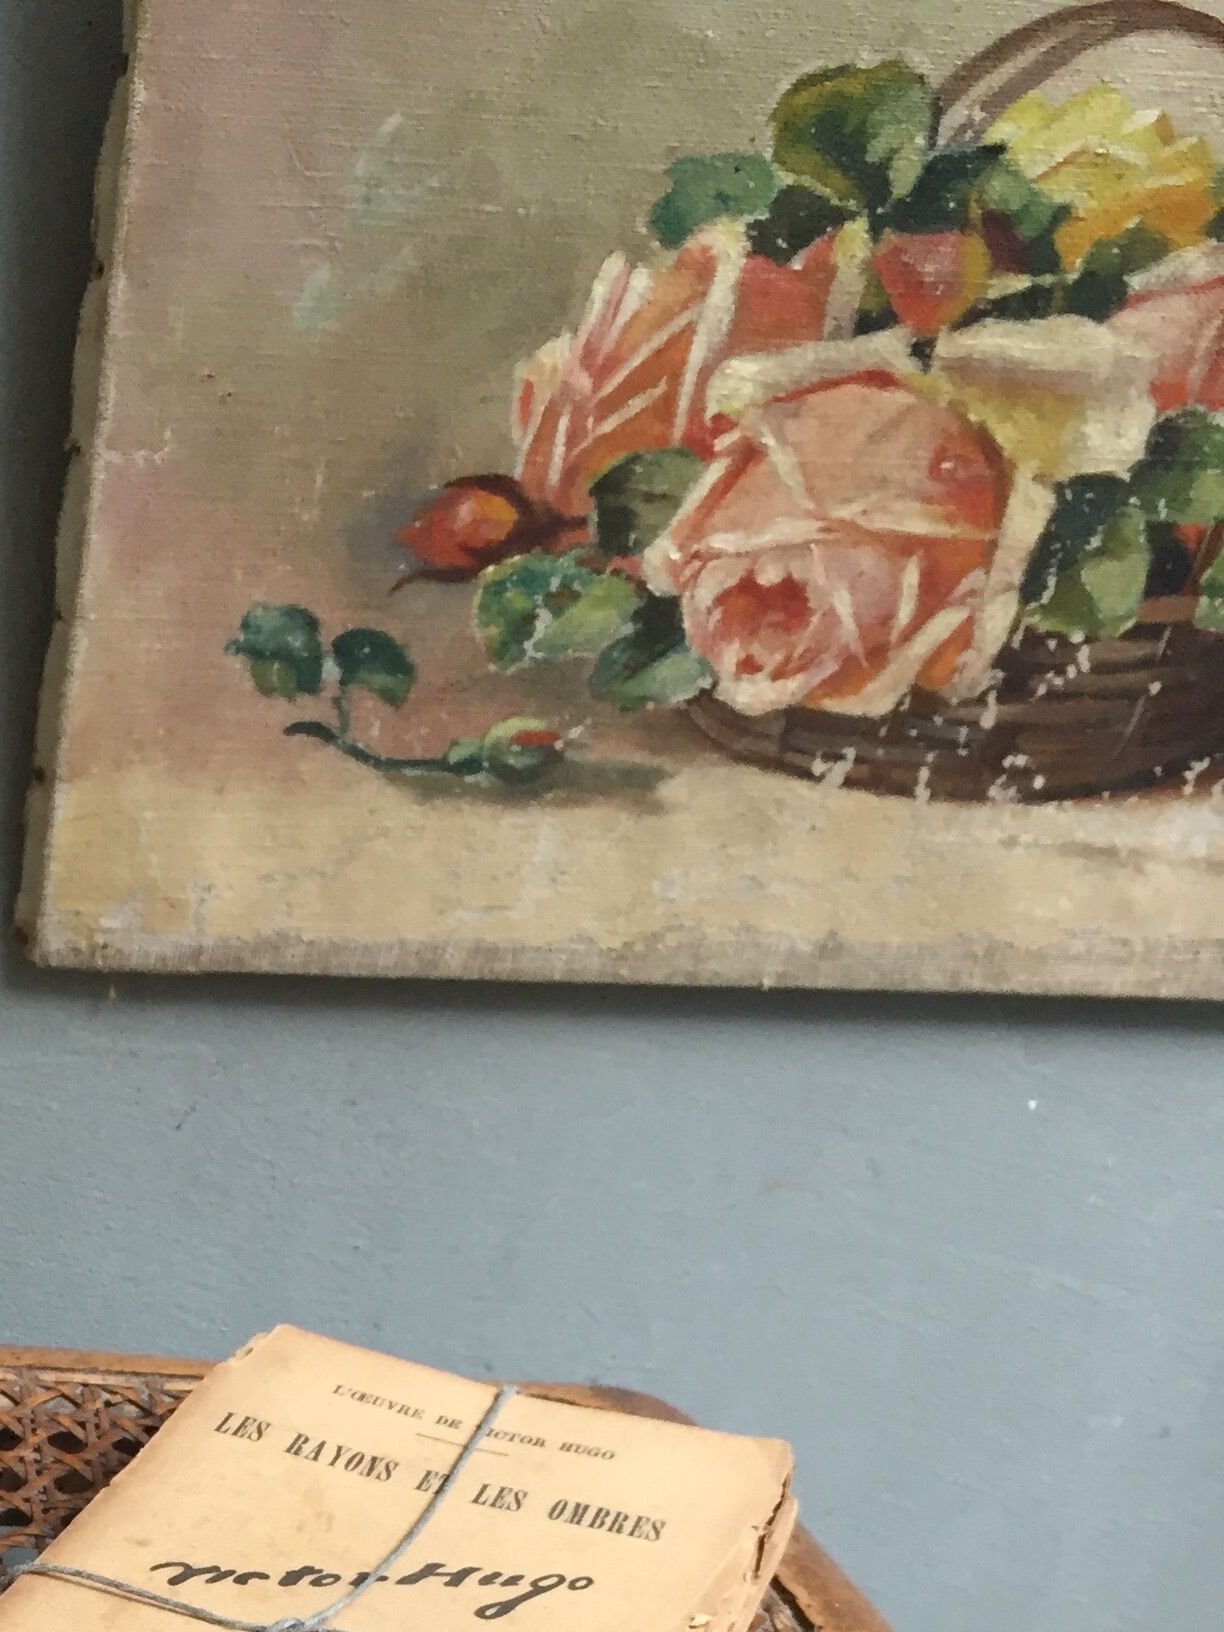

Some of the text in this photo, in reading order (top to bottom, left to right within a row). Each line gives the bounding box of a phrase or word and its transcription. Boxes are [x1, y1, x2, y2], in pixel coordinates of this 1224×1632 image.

[435, 1415, 464, 1429] DE
[475, 1424, 546, 1448] ICTOR
[558, 1441, 616, 1460] HUGO
[214, 1411, 667, 1543] LES RAYONS ET LES OMBRES
[394, 1562, 595, 1620] Hugo
